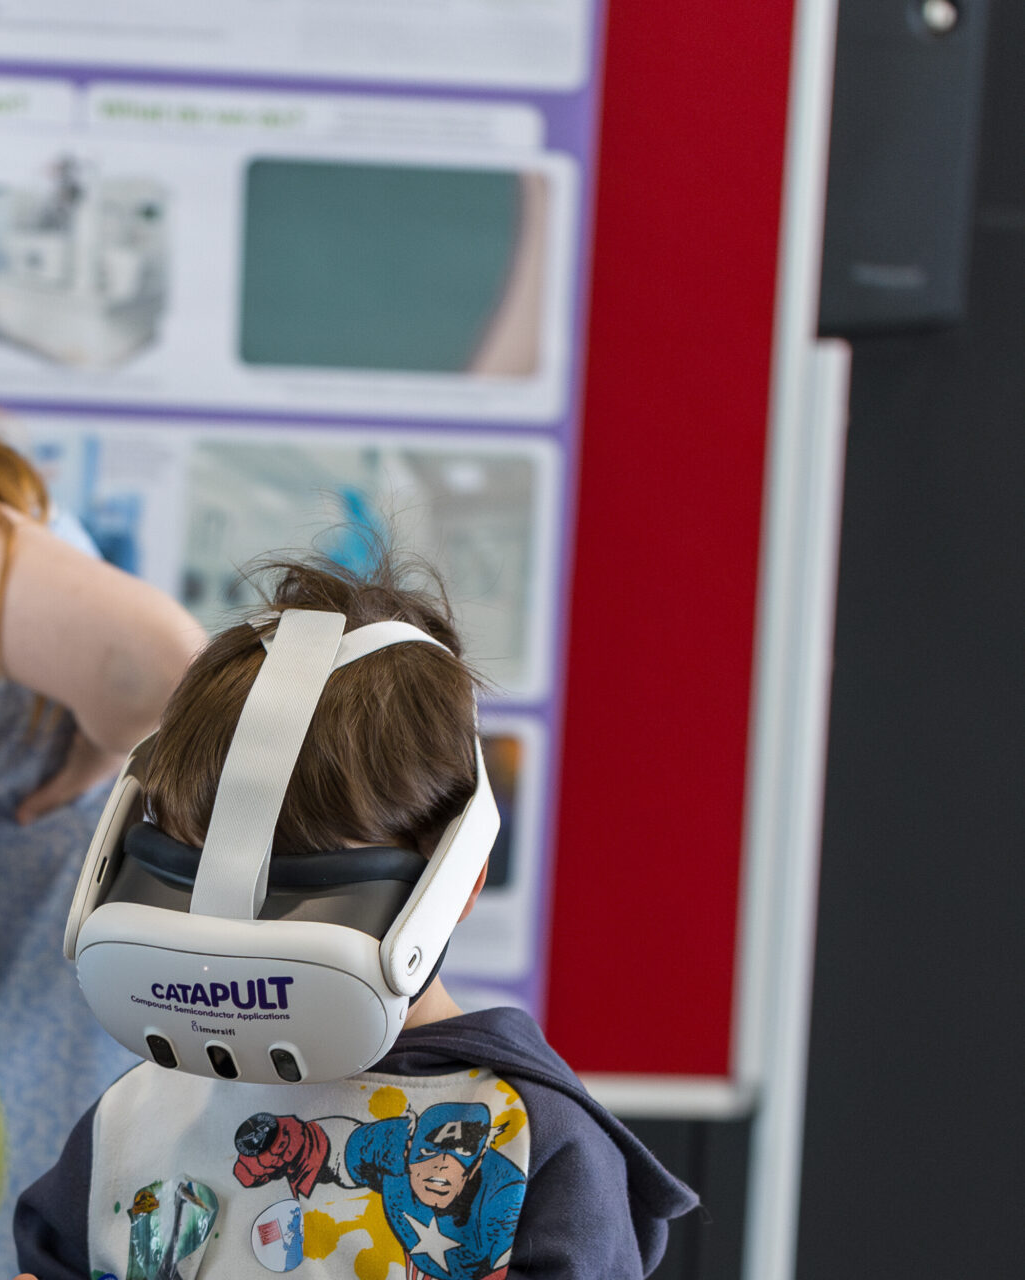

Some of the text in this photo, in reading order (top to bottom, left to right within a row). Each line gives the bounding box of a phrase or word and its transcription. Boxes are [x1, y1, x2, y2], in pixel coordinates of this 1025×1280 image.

[151, 976, 294, 1010] CATAPULT
[130, 995, 290, 1021] Compound Semiconductor Applications
[433, 1120, 462, 1143] A
